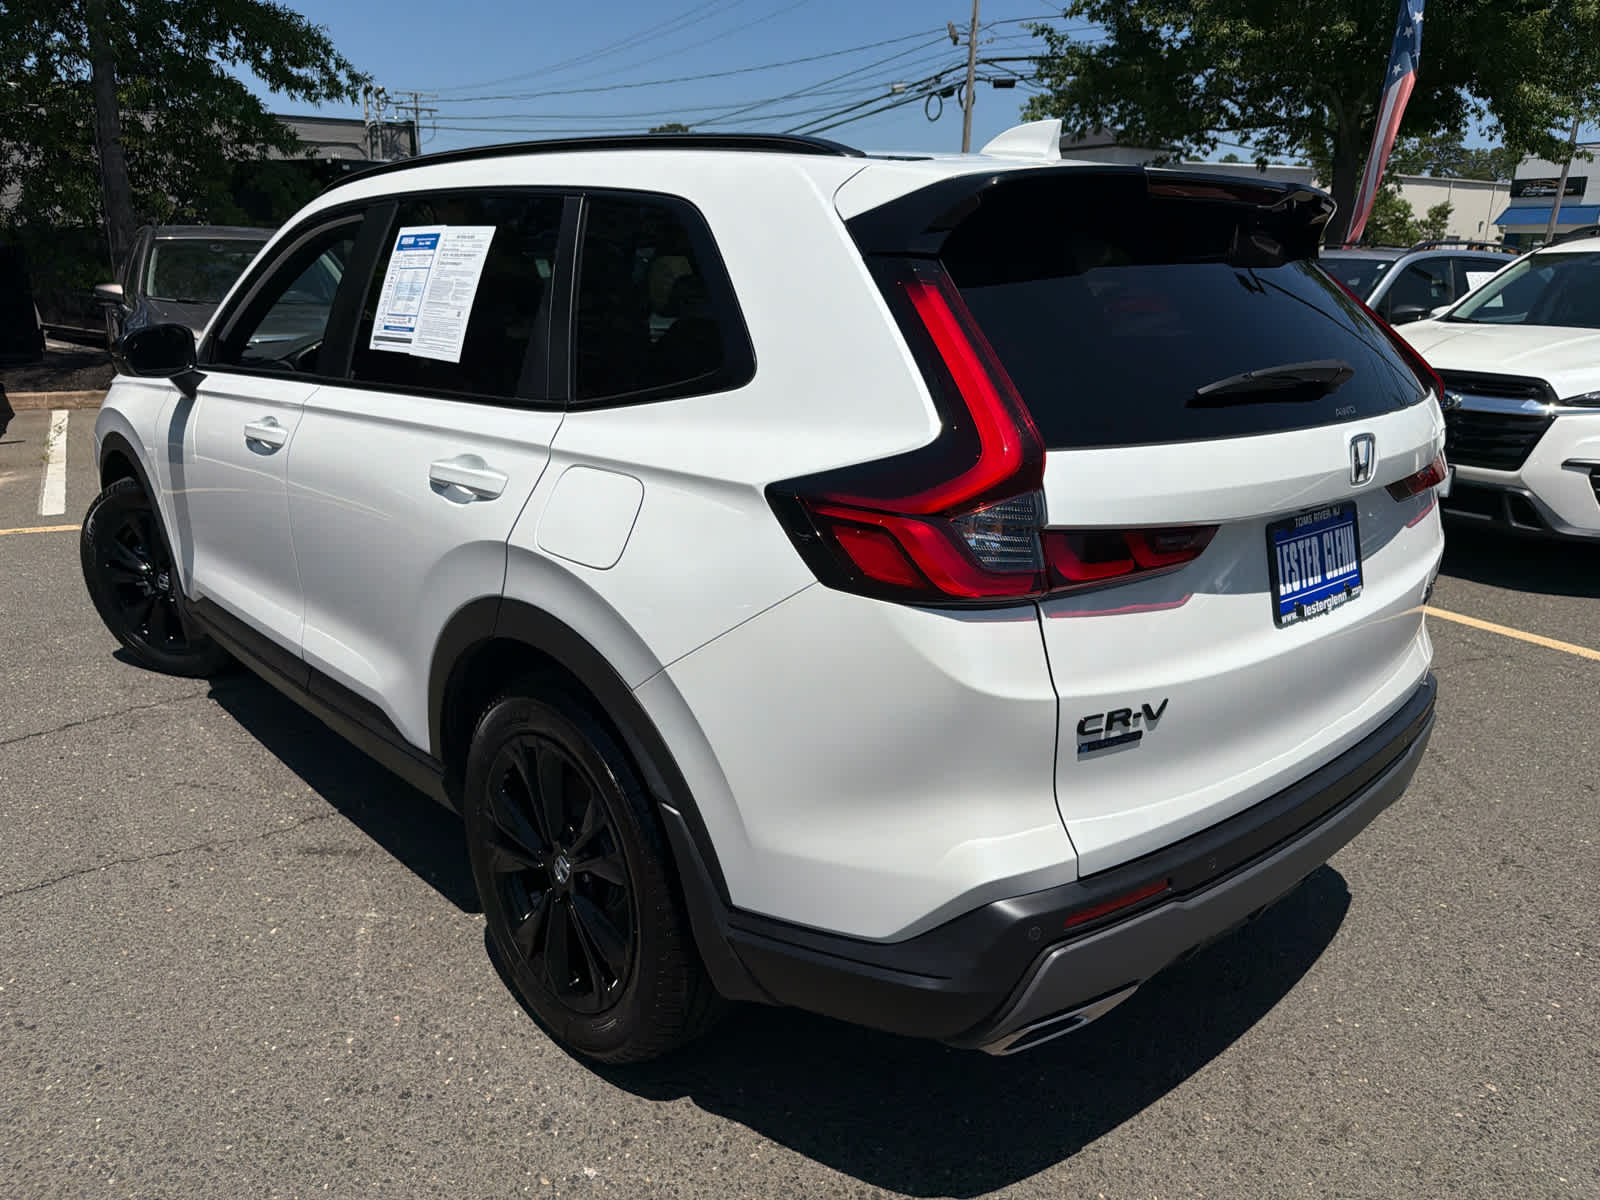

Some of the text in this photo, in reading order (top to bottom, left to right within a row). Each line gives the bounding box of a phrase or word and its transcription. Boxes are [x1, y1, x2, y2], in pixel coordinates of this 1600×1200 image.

[1276, 524, 1358, 597] LESTER GLENN
[1076, 698, 1169, 736] CR-V
